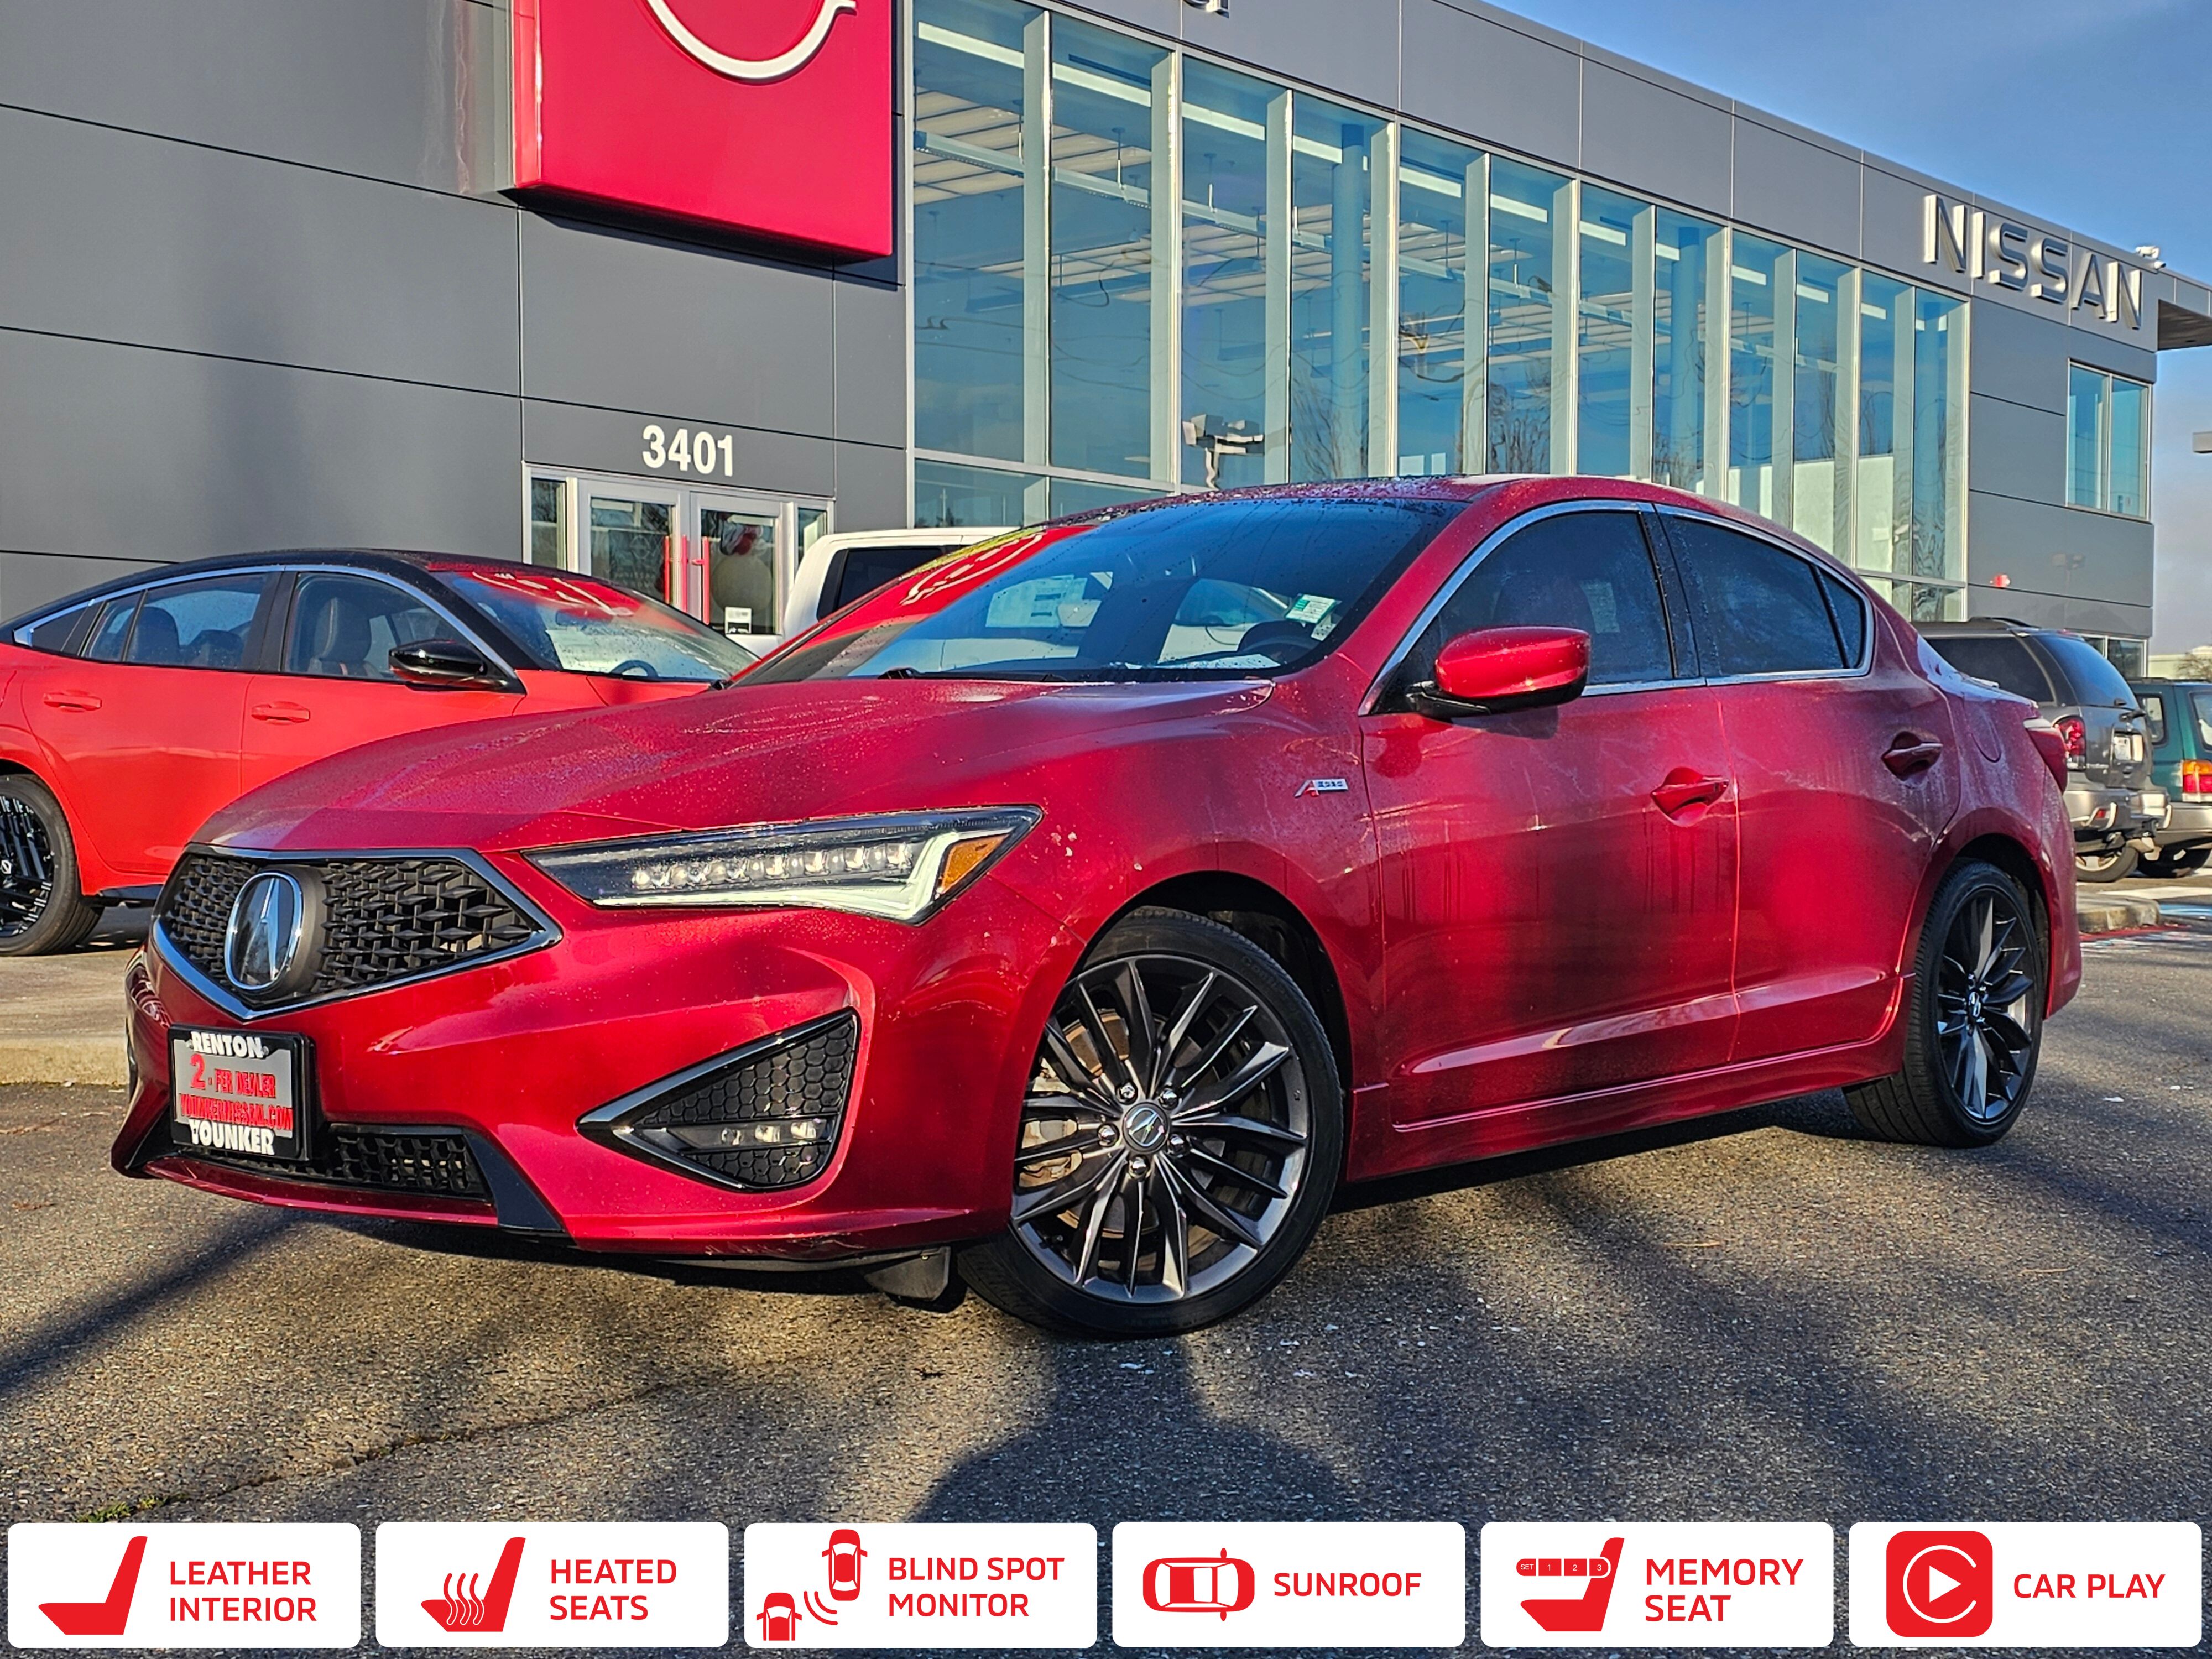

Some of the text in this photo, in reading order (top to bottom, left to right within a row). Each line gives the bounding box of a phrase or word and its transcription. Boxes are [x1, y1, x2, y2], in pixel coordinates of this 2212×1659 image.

[1923, 194, 2142, 330] NISSAN
[642, 424, 734, 477] 3401
[190, 1031, 263, 1058] RENTON
[235, 1071, 276, 1098] DEALER
[188, 1119, 275, 1155] YOUNKER
